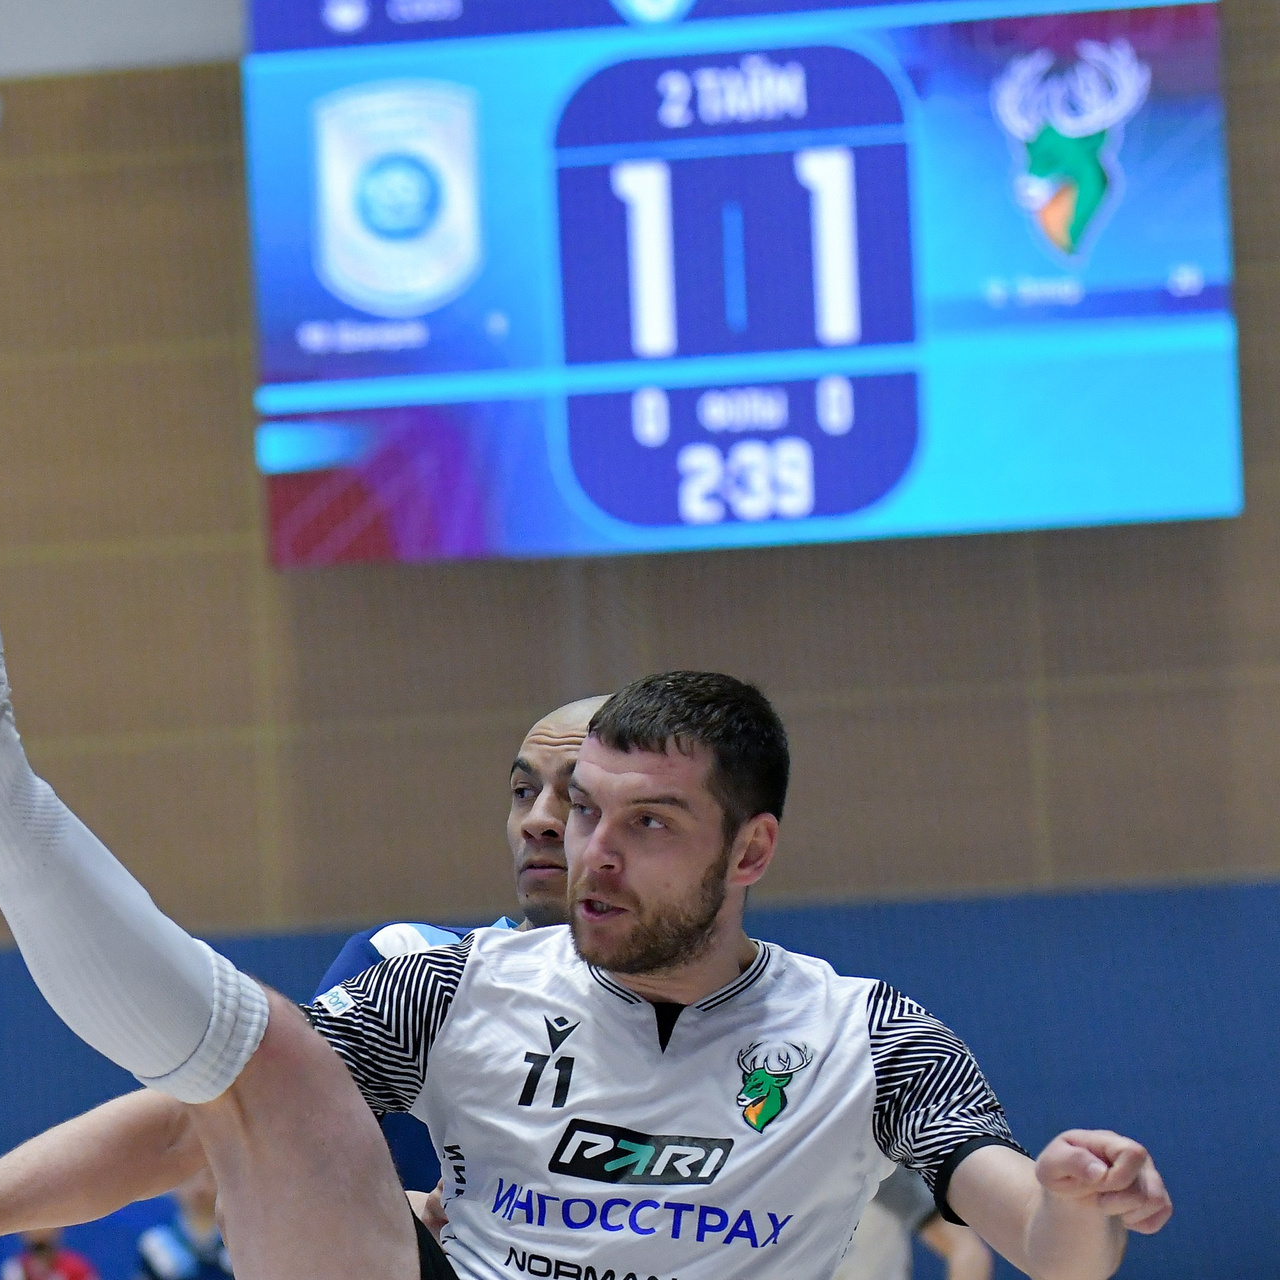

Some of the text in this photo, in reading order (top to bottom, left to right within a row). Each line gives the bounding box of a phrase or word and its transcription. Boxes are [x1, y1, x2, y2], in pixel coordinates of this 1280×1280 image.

[656, 68, 694, 129] 2
[610, 157, 679, 359] 1
[793, 143, 862, 346] 1
[517, 1052, 575, 1108] 71
[559, 1130, 724, 1178] PARI
[491, 1177, 794, 1248] ИНГОССТРАХ
